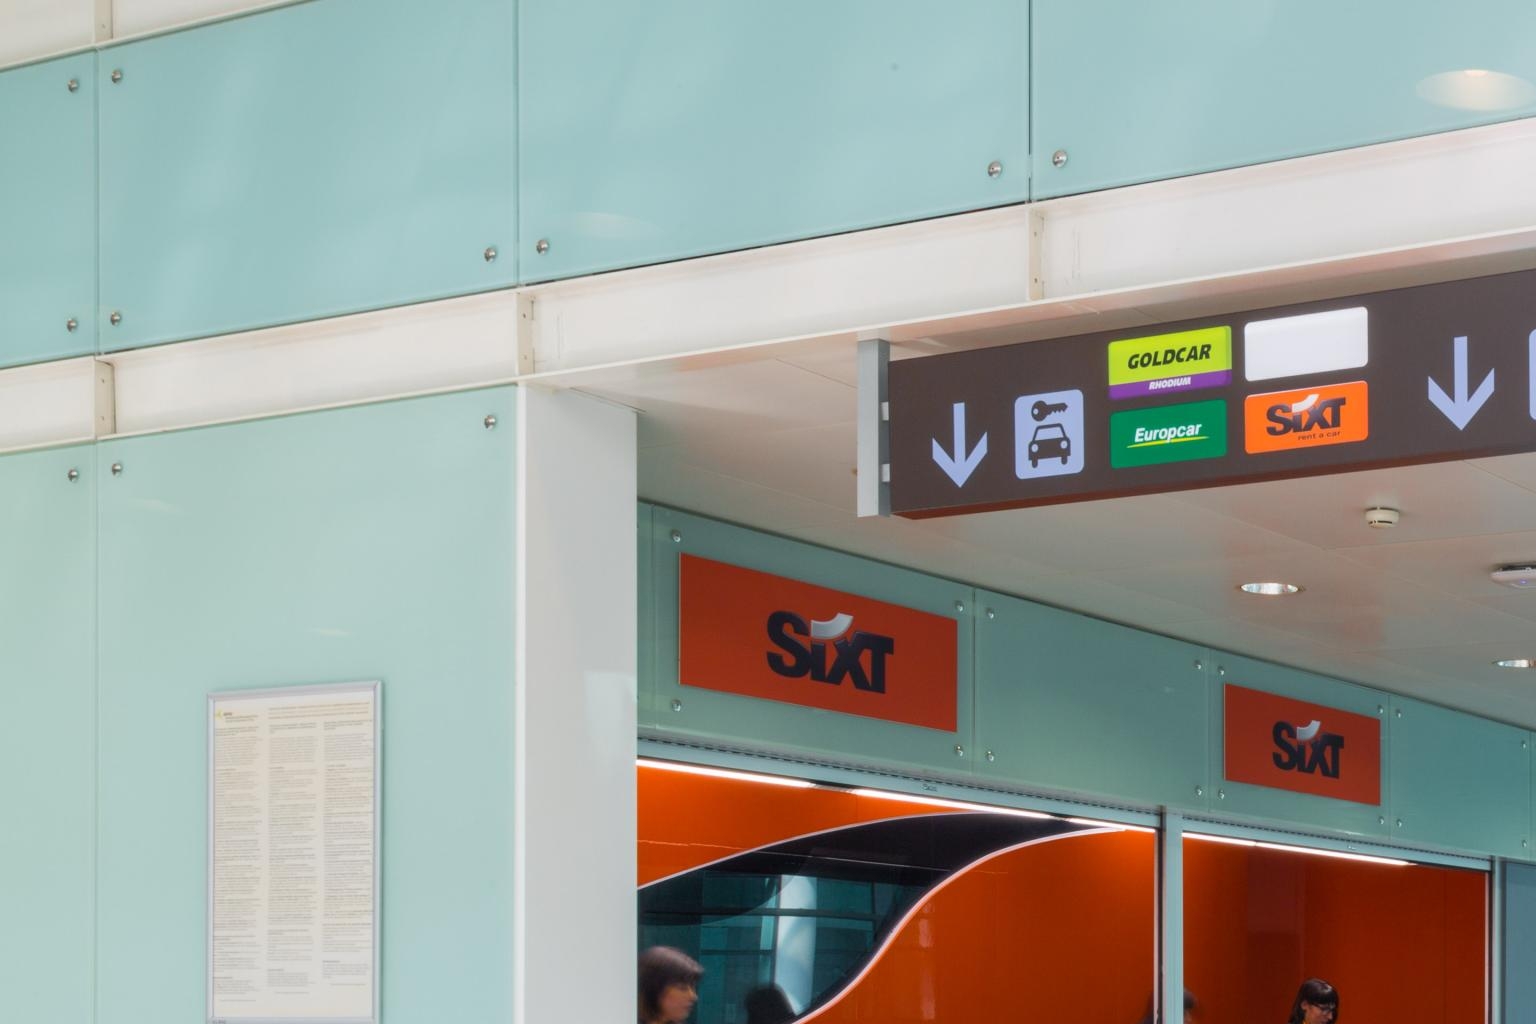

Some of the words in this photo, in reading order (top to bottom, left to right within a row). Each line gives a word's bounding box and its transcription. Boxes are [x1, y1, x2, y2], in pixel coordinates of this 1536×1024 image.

[1127, 344, 1212, 370] GOLDCAR
[1148, 376, 1192, 390] RHODIUM
[1134, 423, 1202, 444] Europcar
[1297, 432, 1316, 441] rent
[1327, 430, 1341, 438] car
